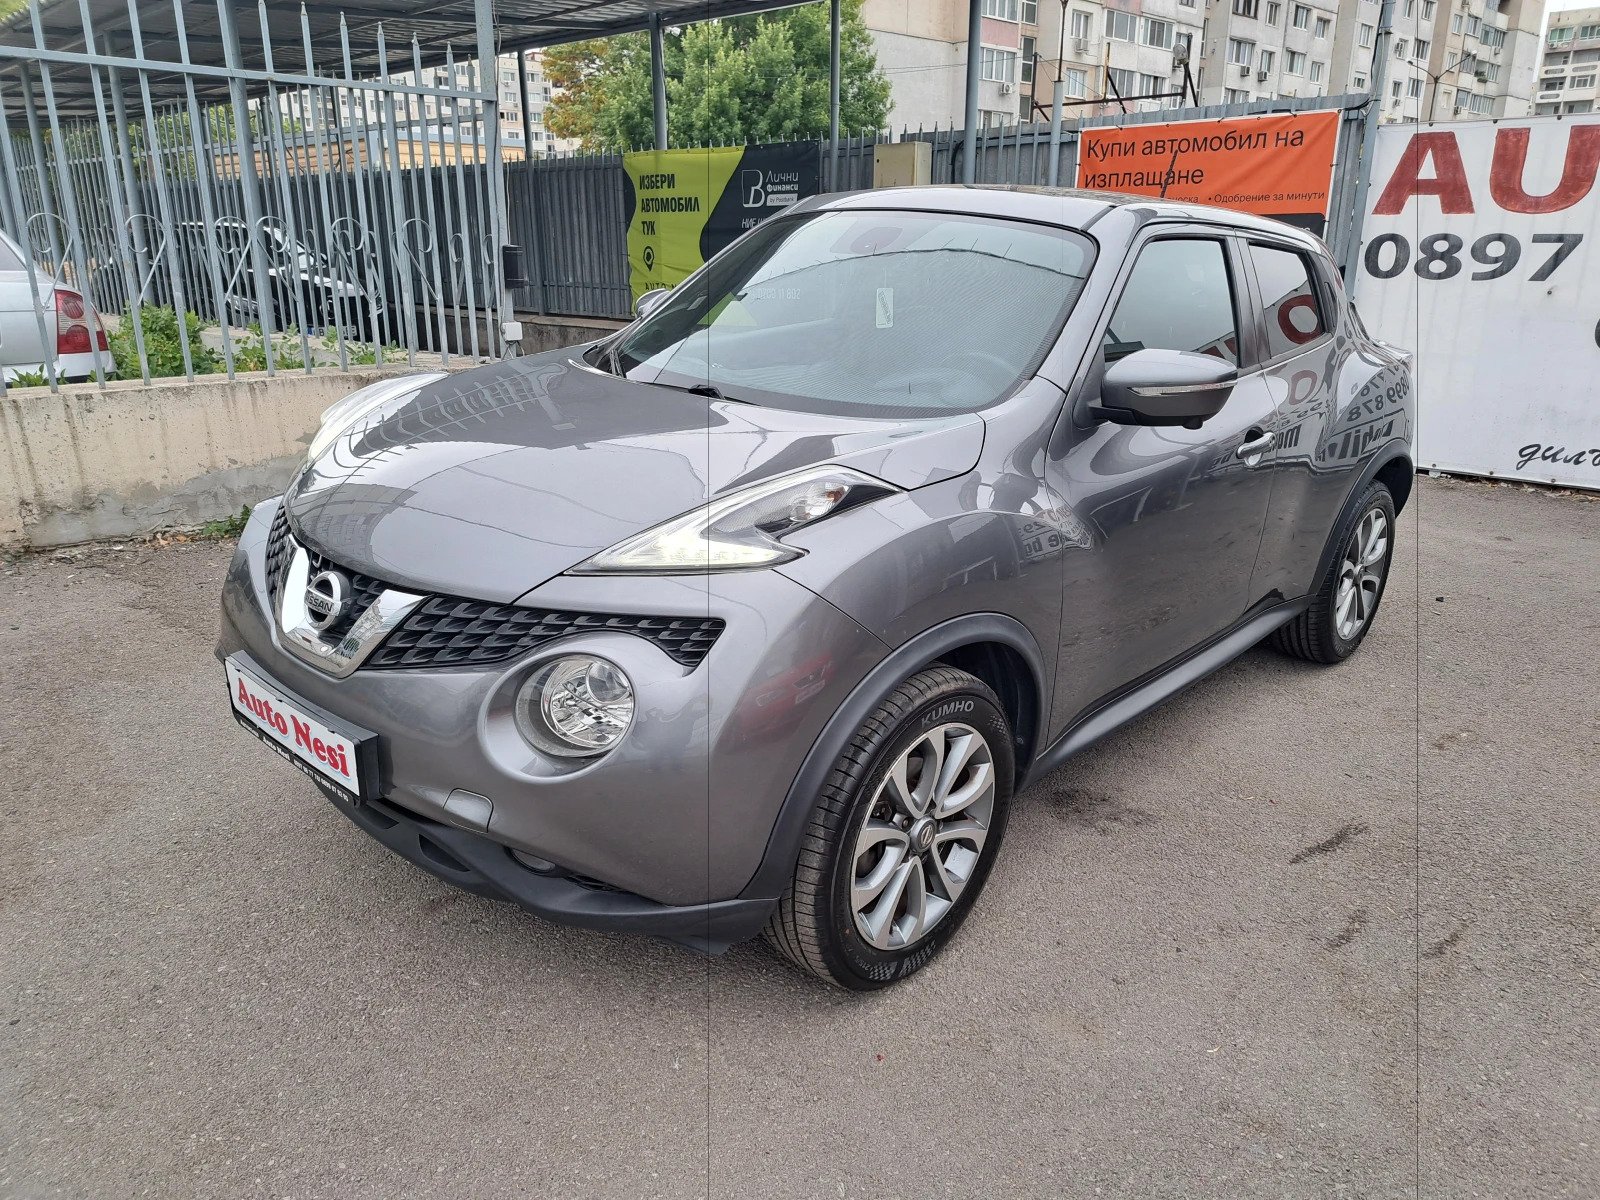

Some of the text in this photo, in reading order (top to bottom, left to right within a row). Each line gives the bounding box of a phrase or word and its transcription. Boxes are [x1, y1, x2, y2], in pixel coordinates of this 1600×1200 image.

[1087, 129, 1305, 162] Купи автомобил на
[766, 170, 799, 183] Лични
[1085, 167, 1204, 189] изплащане
[1372, 125, 1600, 215] AU
[639, 173, 676, 191] ИЗБЕРИ
[641, 196, 700, 213] АВТОМОБИЛ
[1213, 193, 1270, 204] Одобрение
[1285, 191, 1325, 203] минути
[642, 221, 656, 236] ТУК
[1364, 233, 1583, 282] 0897
[786, 288, 801, 300] 802
[920, 700, 975, 727] KUMHO
[238, 678, 350, 777] Auto Nesi
